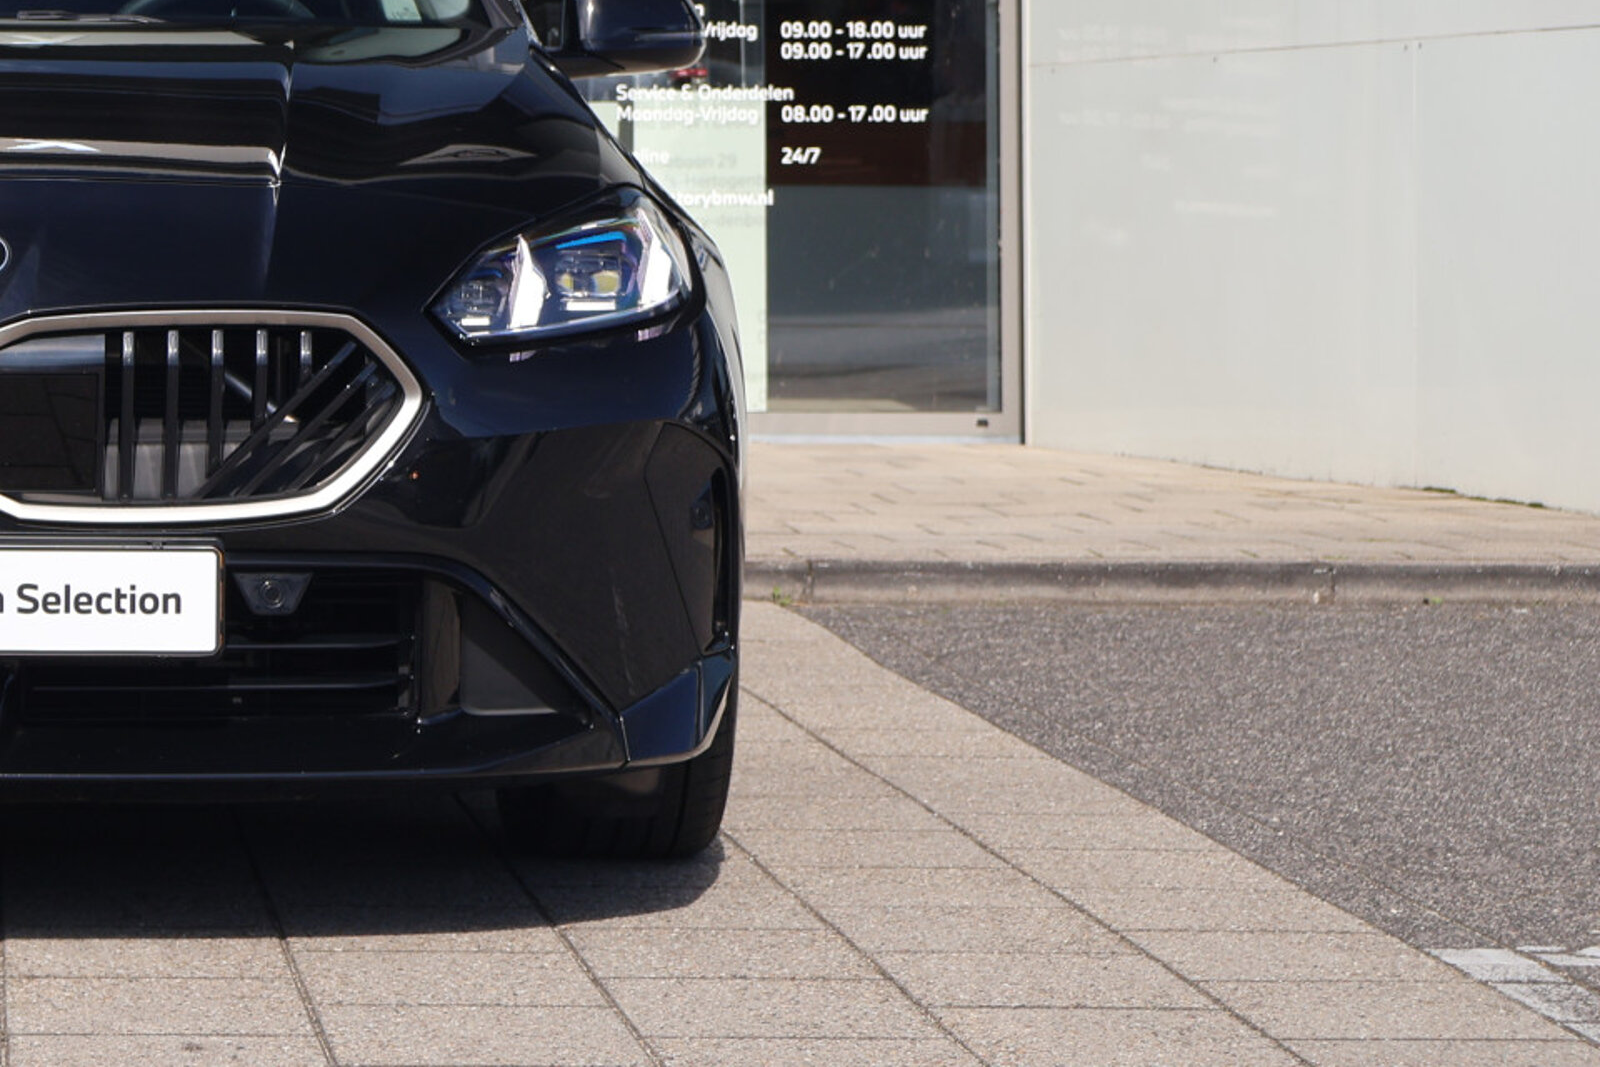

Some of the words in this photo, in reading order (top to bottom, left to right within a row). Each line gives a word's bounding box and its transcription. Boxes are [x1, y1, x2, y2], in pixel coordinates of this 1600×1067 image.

[780, 20, 833, 39] 09.00
[846, 20, 896, 39] 18.00
[897, 25, 928, 39] uur
[780, 41, 833, 60] 09.00
[898, 46, 929, 60] uur
[615, 84, 679, 101] Service
[681, 84, 694, 101] &
[697, 84, 795, 101] Onderdelen
[615, 106, 759, 126] Maandag-Vrijdag
[781, 104, 834, 123] 08.00
[899, 108, 929, 123] uur
[781, 146, 821, 165] 24/7
[15, 583, 183, 615] Selection
